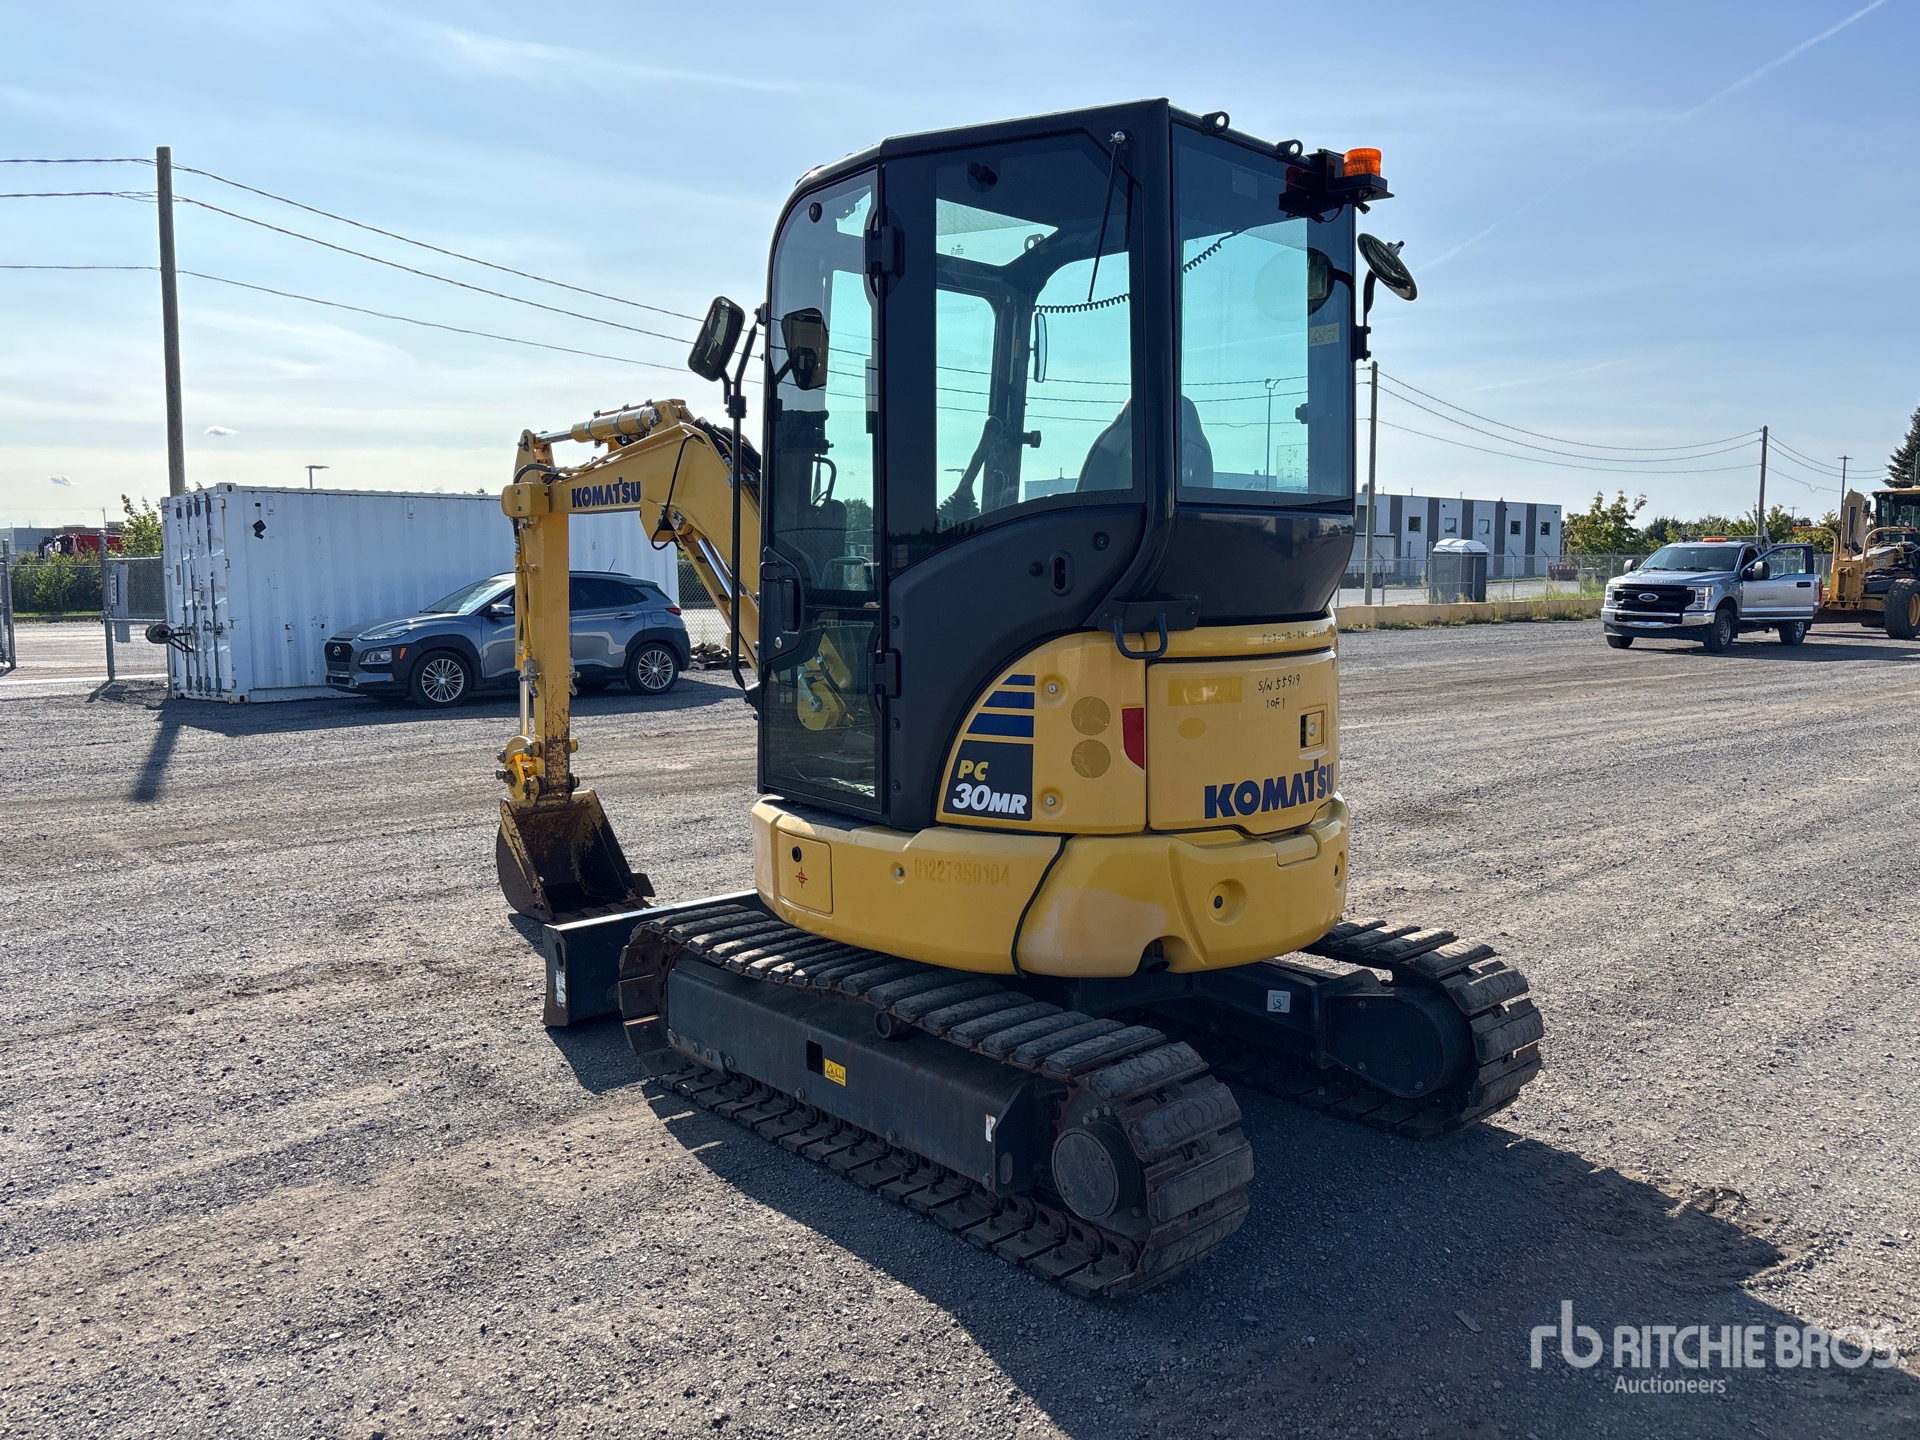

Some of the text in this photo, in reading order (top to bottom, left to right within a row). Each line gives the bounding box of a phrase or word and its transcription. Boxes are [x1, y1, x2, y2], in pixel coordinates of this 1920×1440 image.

[572, 477, 641, 508] KOMATSU
[1258, 677, 1273, 694] S/N
[957, 759, 990, 781] PC
[952, 782, 1028, 815] 30MR
[1204, 758, 1335, 819] KOMATSU
